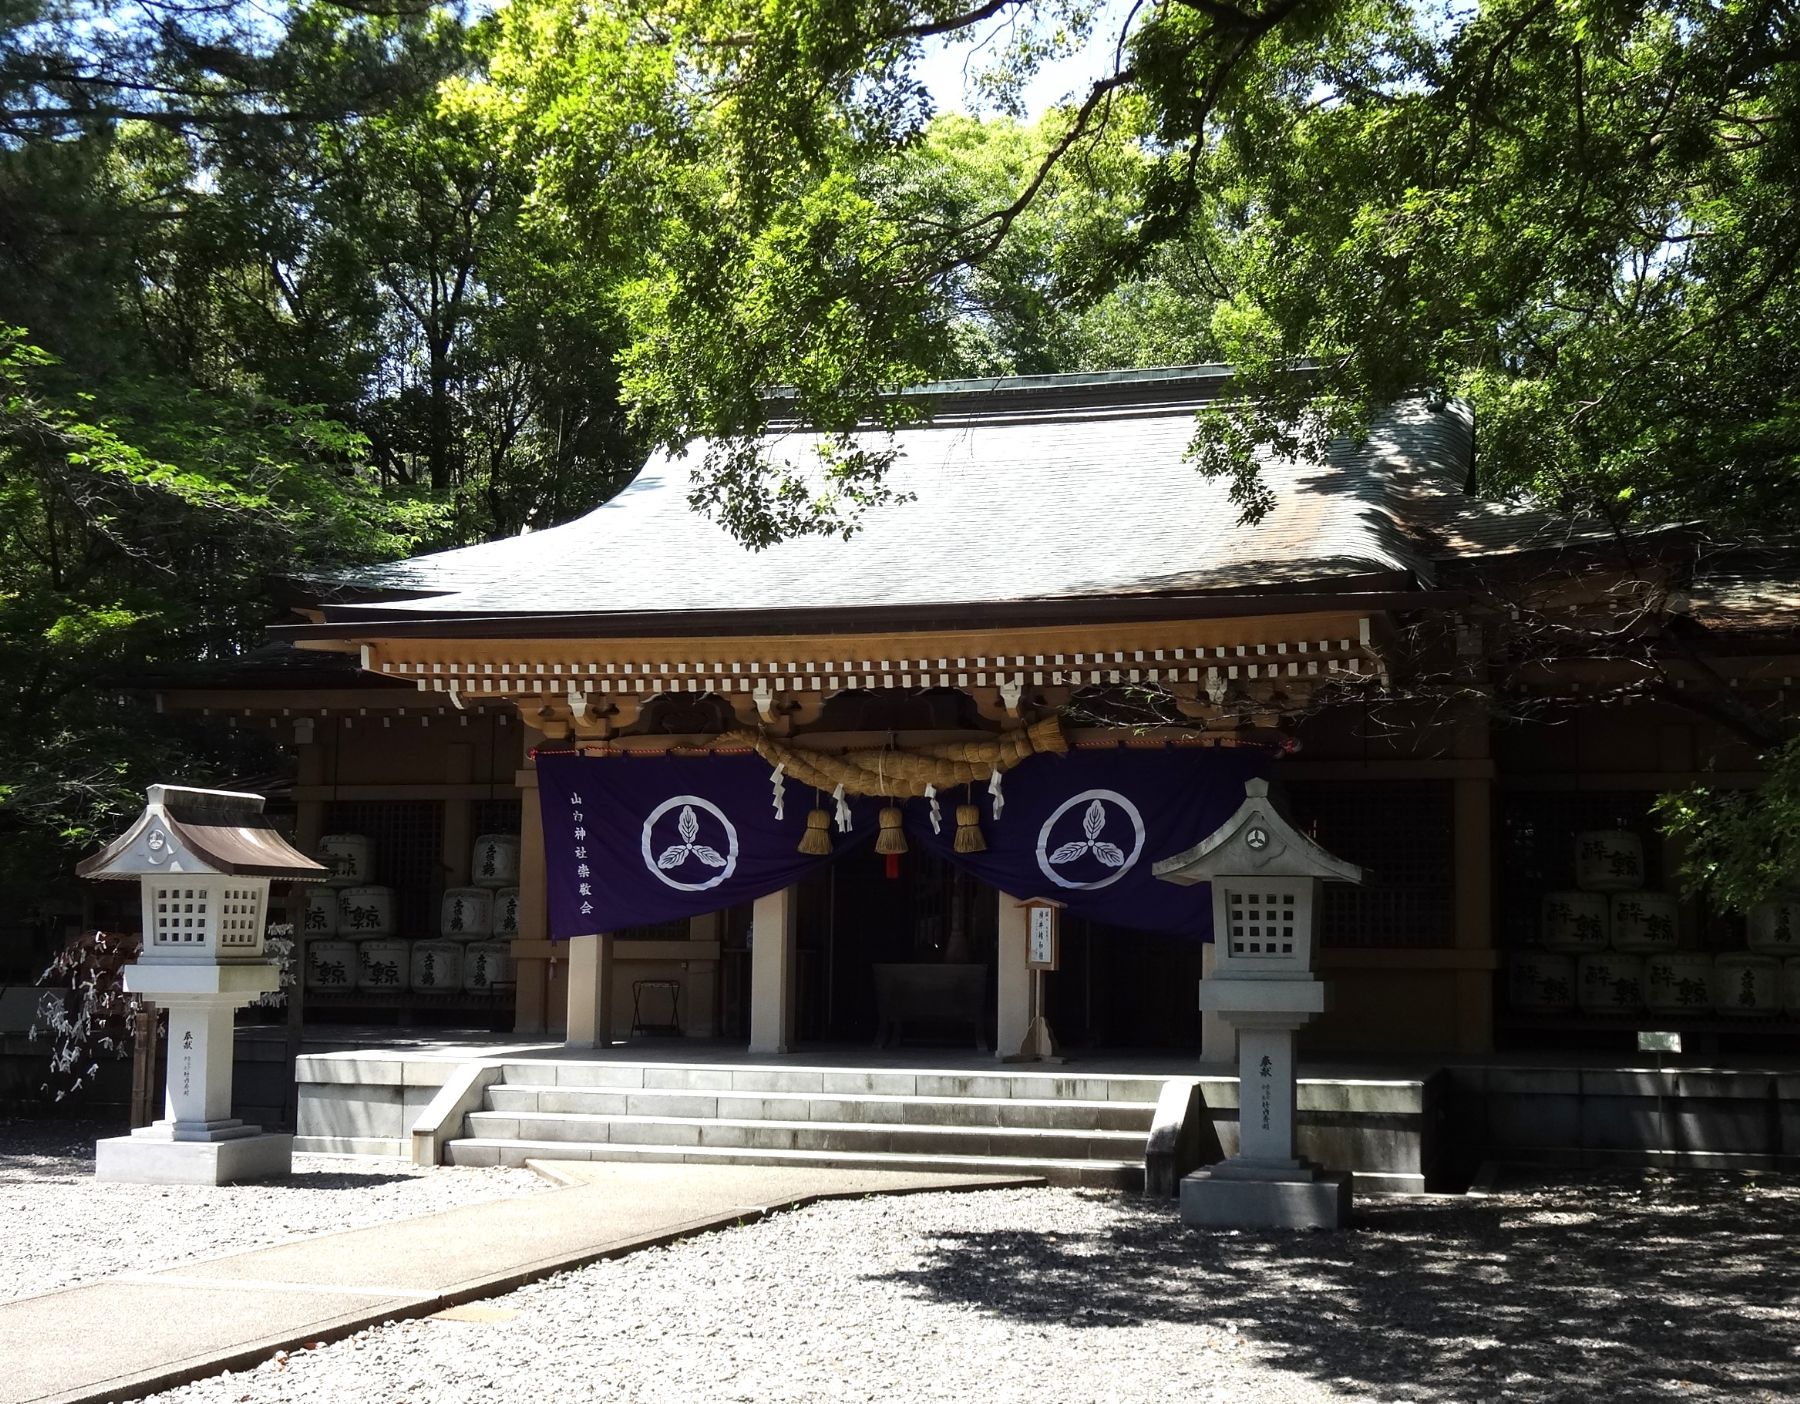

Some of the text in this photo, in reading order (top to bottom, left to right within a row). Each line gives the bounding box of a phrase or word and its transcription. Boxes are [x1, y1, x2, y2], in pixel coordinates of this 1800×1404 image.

[571, 792, 594, 914] 山内神社崇敬会
